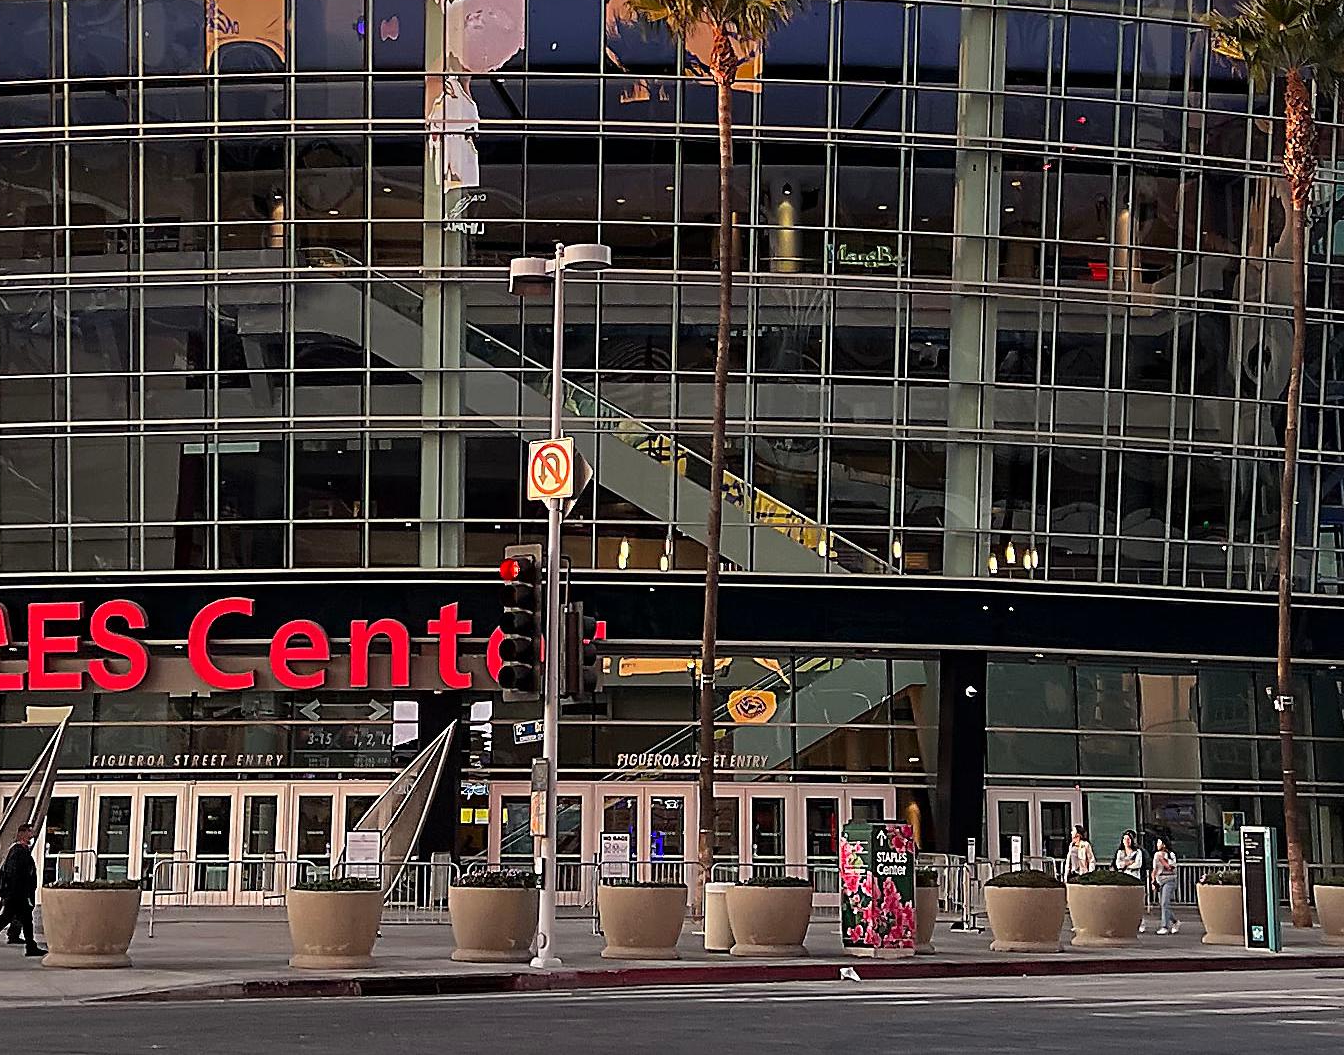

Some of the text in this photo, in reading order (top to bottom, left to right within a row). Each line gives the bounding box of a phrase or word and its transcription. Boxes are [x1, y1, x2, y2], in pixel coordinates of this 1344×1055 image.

[187, 598, 605, 690] Cent
[92, 754, 284, 767] FIGUEROA STREET ENTRY
[617, 753, 769, 768] FIGUEROA STET ENTRY
[876, 851, 908, 864] STAPLES
[876, 863, 907, 876] Center
